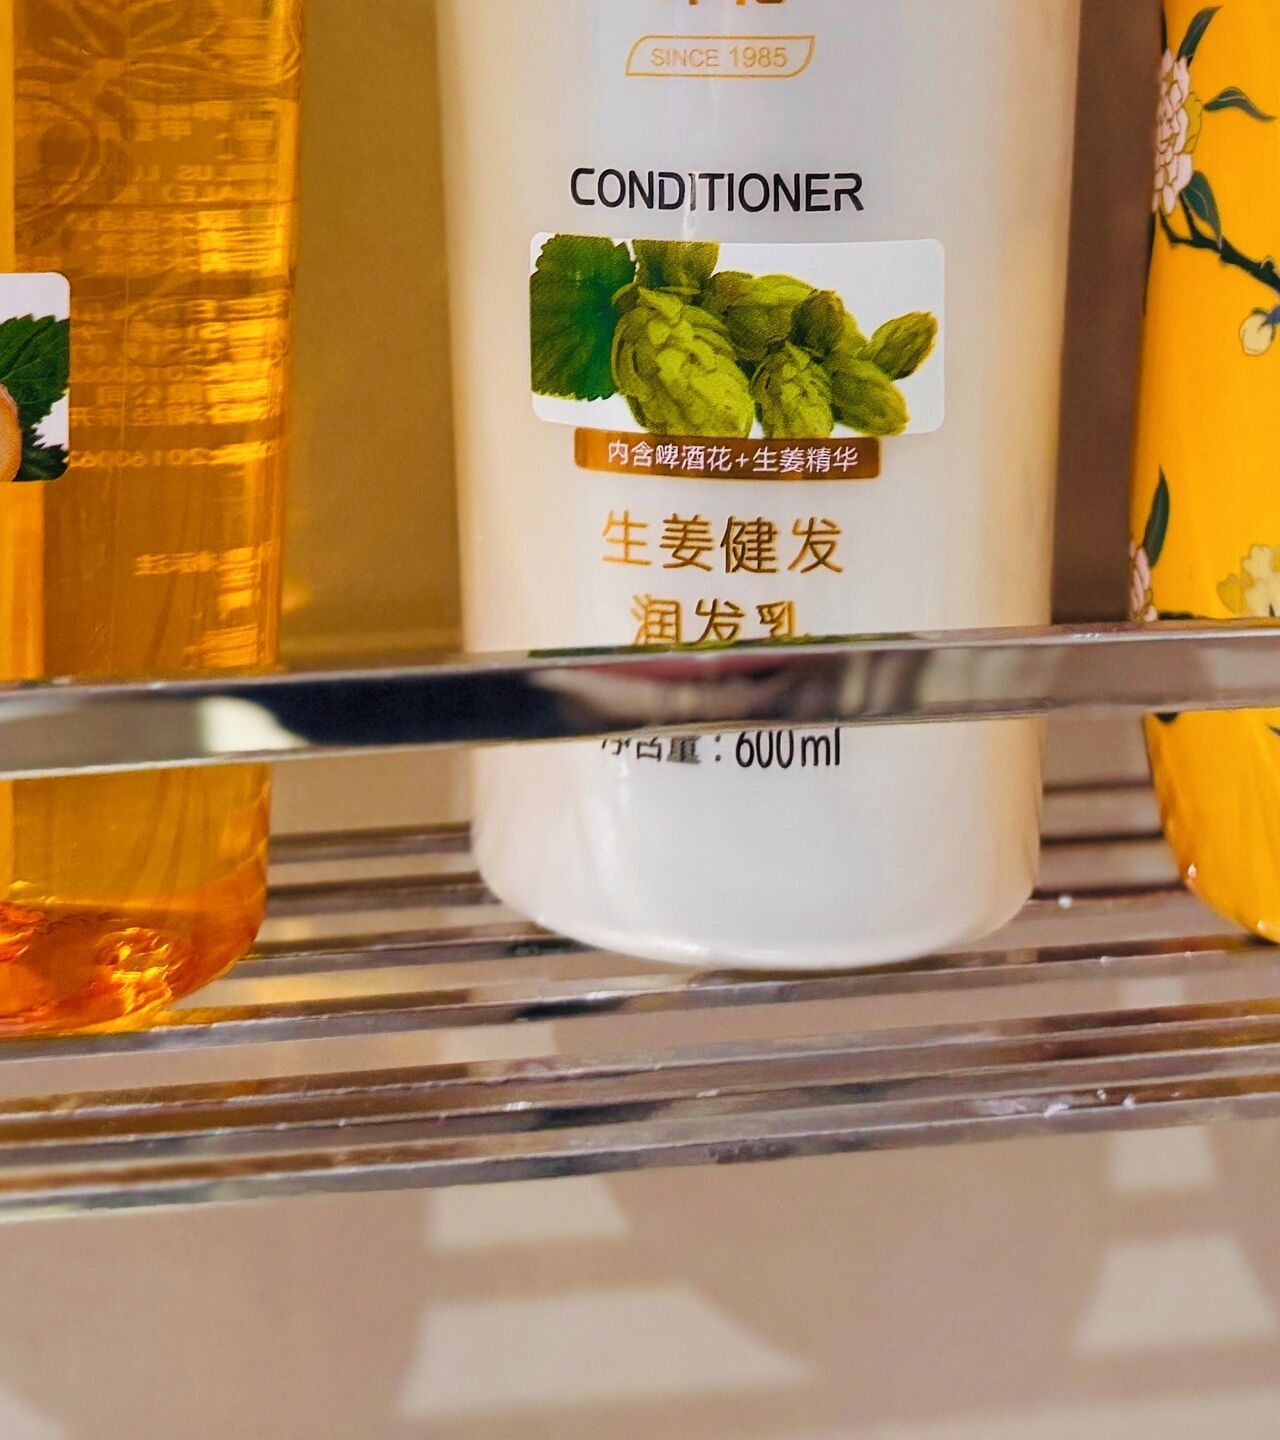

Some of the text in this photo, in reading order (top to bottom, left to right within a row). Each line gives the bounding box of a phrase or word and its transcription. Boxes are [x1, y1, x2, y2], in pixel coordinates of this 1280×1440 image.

[651, 47, 788, 68] SINCE 1985
[570, 167, 865, 213] CONDITIONER
[608, 440, 858, 474] 内含啤酒花+生姜精华
[601, 509, 844, 575] 生姜健发
